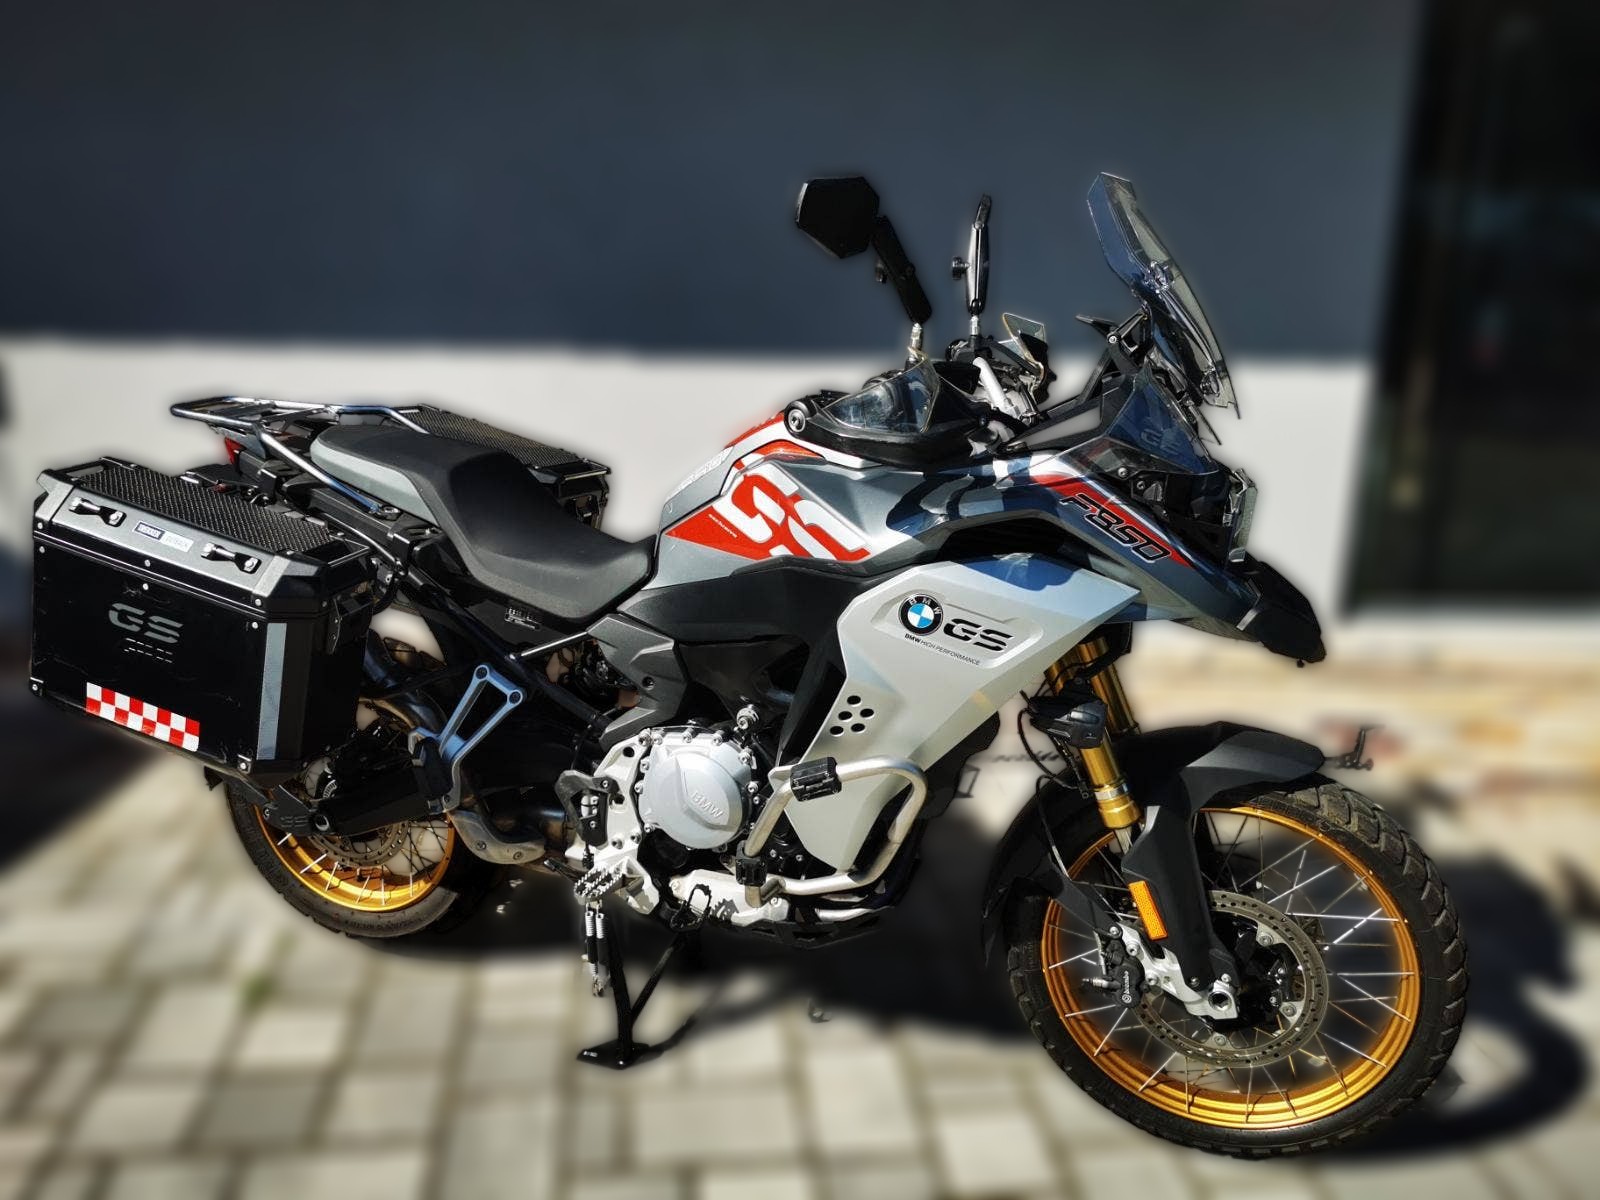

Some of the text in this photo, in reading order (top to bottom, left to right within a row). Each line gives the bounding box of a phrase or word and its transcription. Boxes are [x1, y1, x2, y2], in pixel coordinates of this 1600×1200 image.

[1059, 492, 1172, 564] F850
[108, 602, 184, 644] GS
[943, 617, 1014, 652] GS
[904, 632, 980, 666] BMW HIGH PERFORMANCE
[690, 790, 724, 818] BMW
